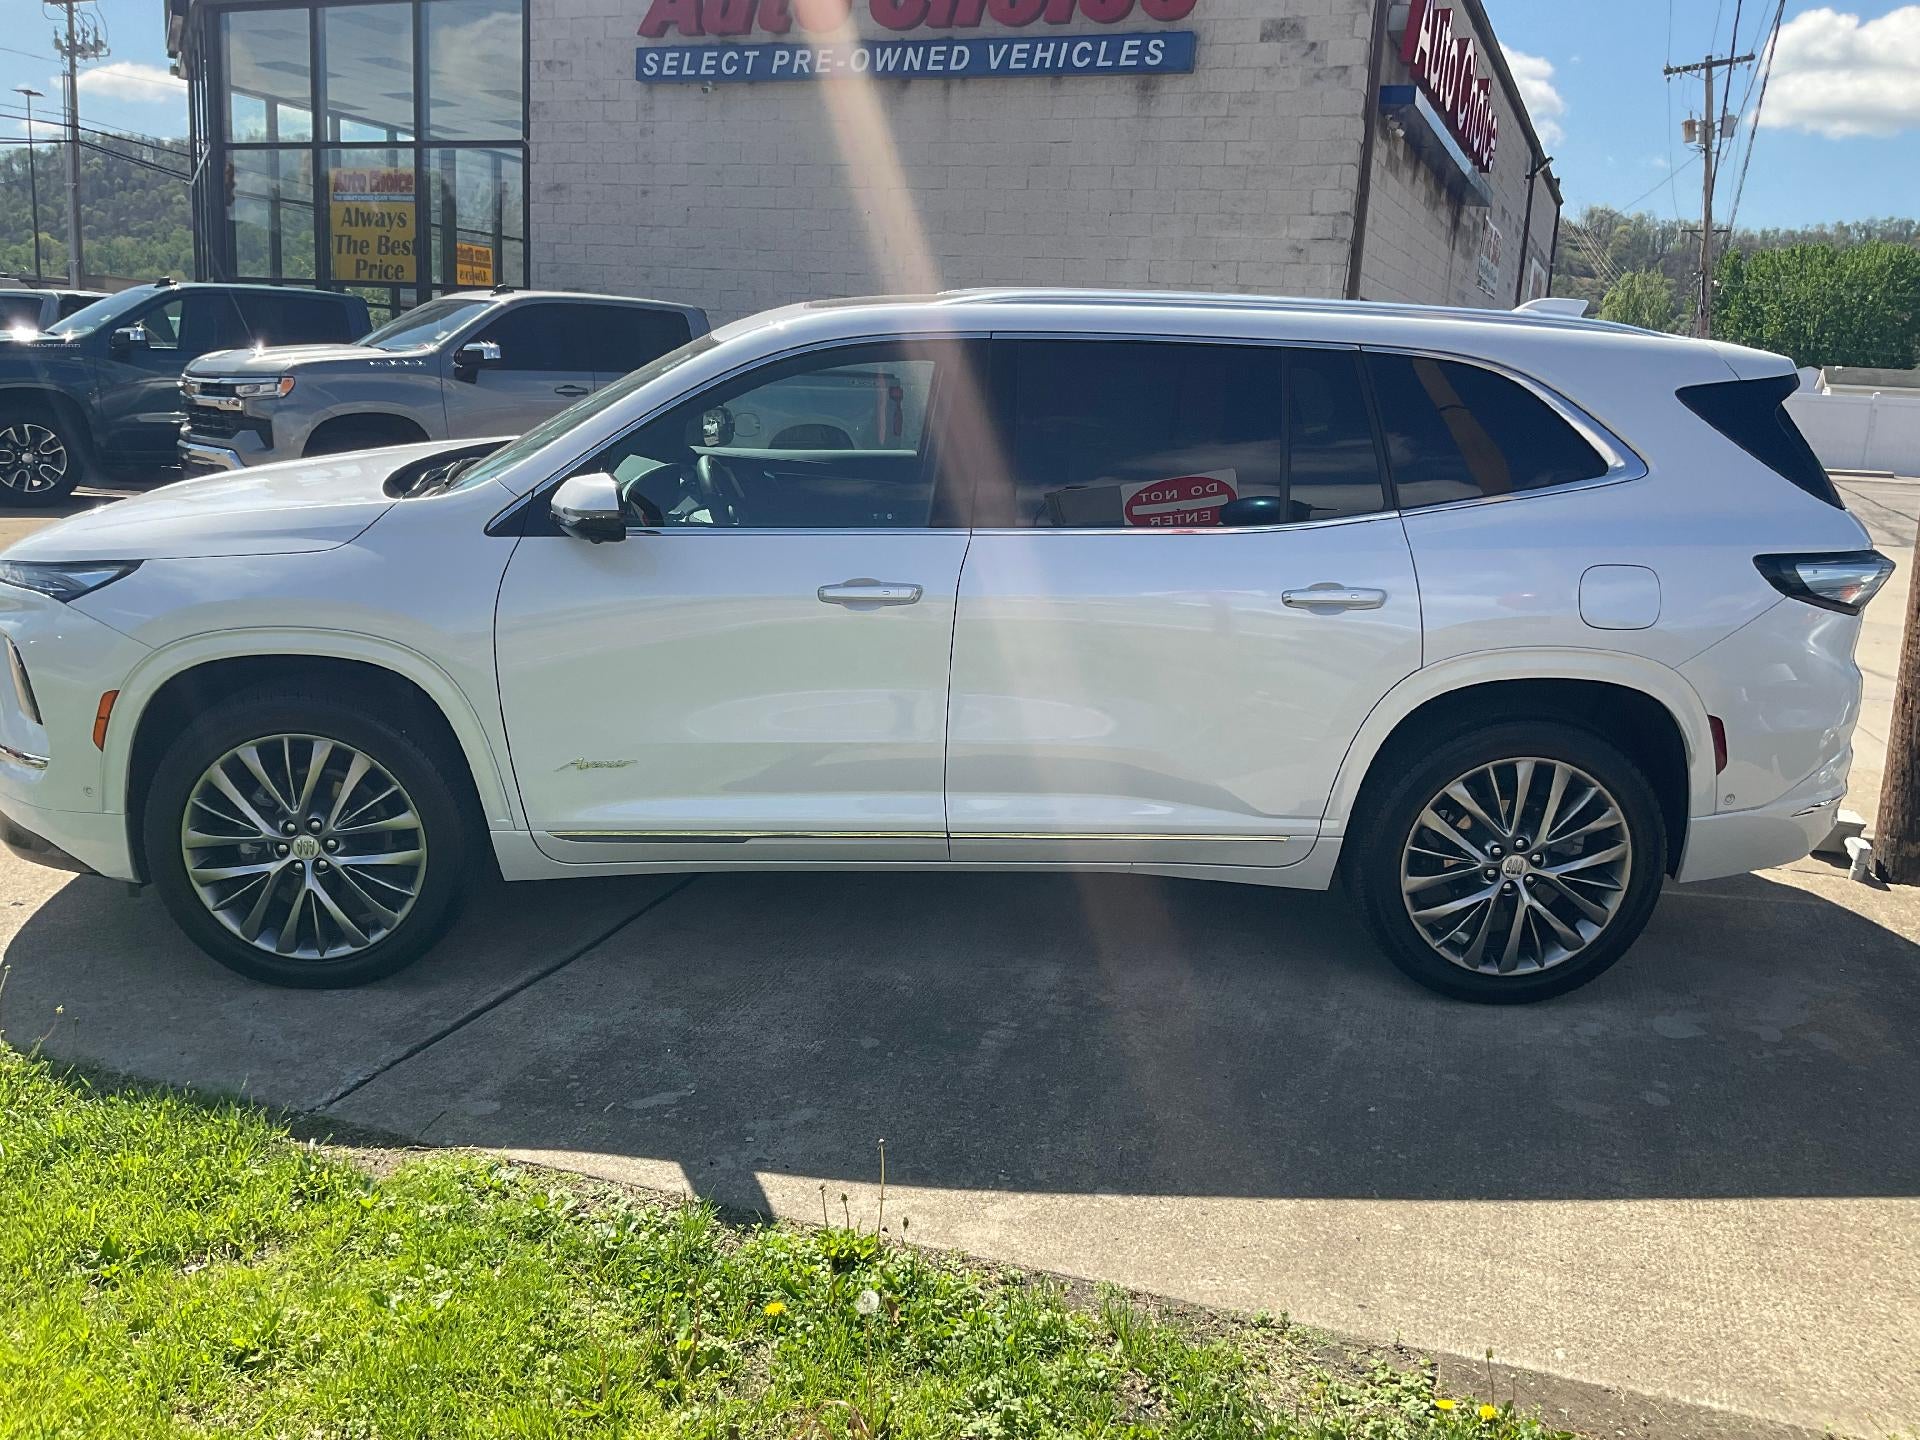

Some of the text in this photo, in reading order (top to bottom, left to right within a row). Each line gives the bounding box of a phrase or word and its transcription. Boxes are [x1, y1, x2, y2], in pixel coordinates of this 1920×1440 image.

[643, 39, 1165, 76] SELECT PRE-OWNED VEHICLES
[1413, 0, 1458, 113] Auto
[1457, 38, 1498, 173] Choice
[341, 207, 407, 232] Always
[334, 234, 370, 255] The
[355, 258, 405, 281] Price
